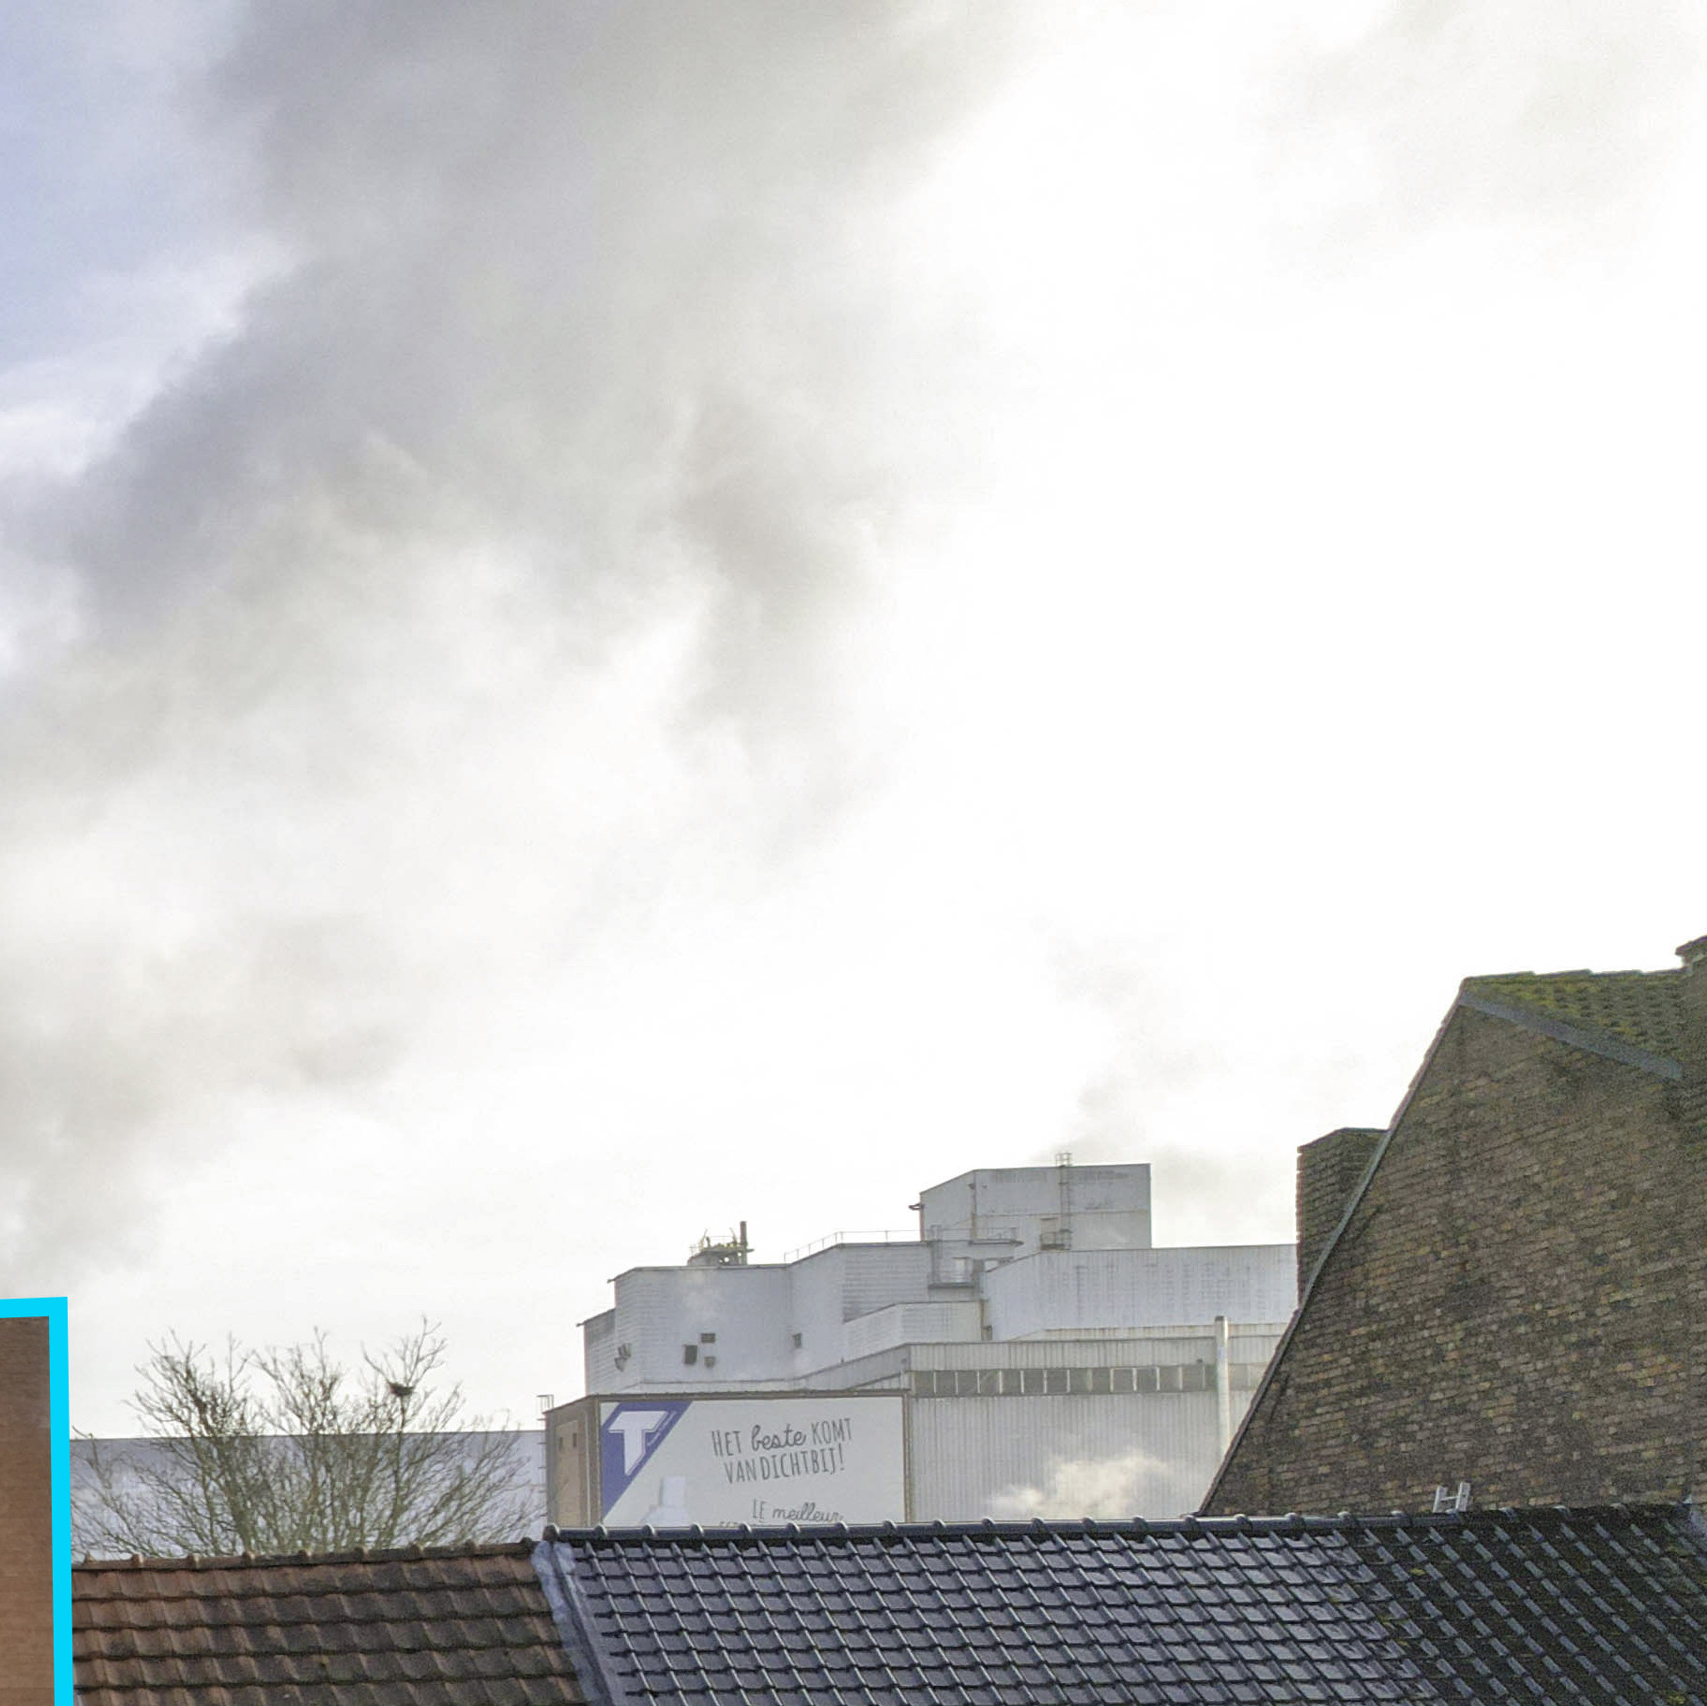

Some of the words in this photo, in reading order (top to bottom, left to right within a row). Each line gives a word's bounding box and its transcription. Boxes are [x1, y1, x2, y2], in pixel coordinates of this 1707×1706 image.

[711, 1429, 742, 1457] HET
[751, 1424, 807, 1451] beste
[811, 1418, 853, 1446] KOMT
[751, 1498, 766, 1520] LE
